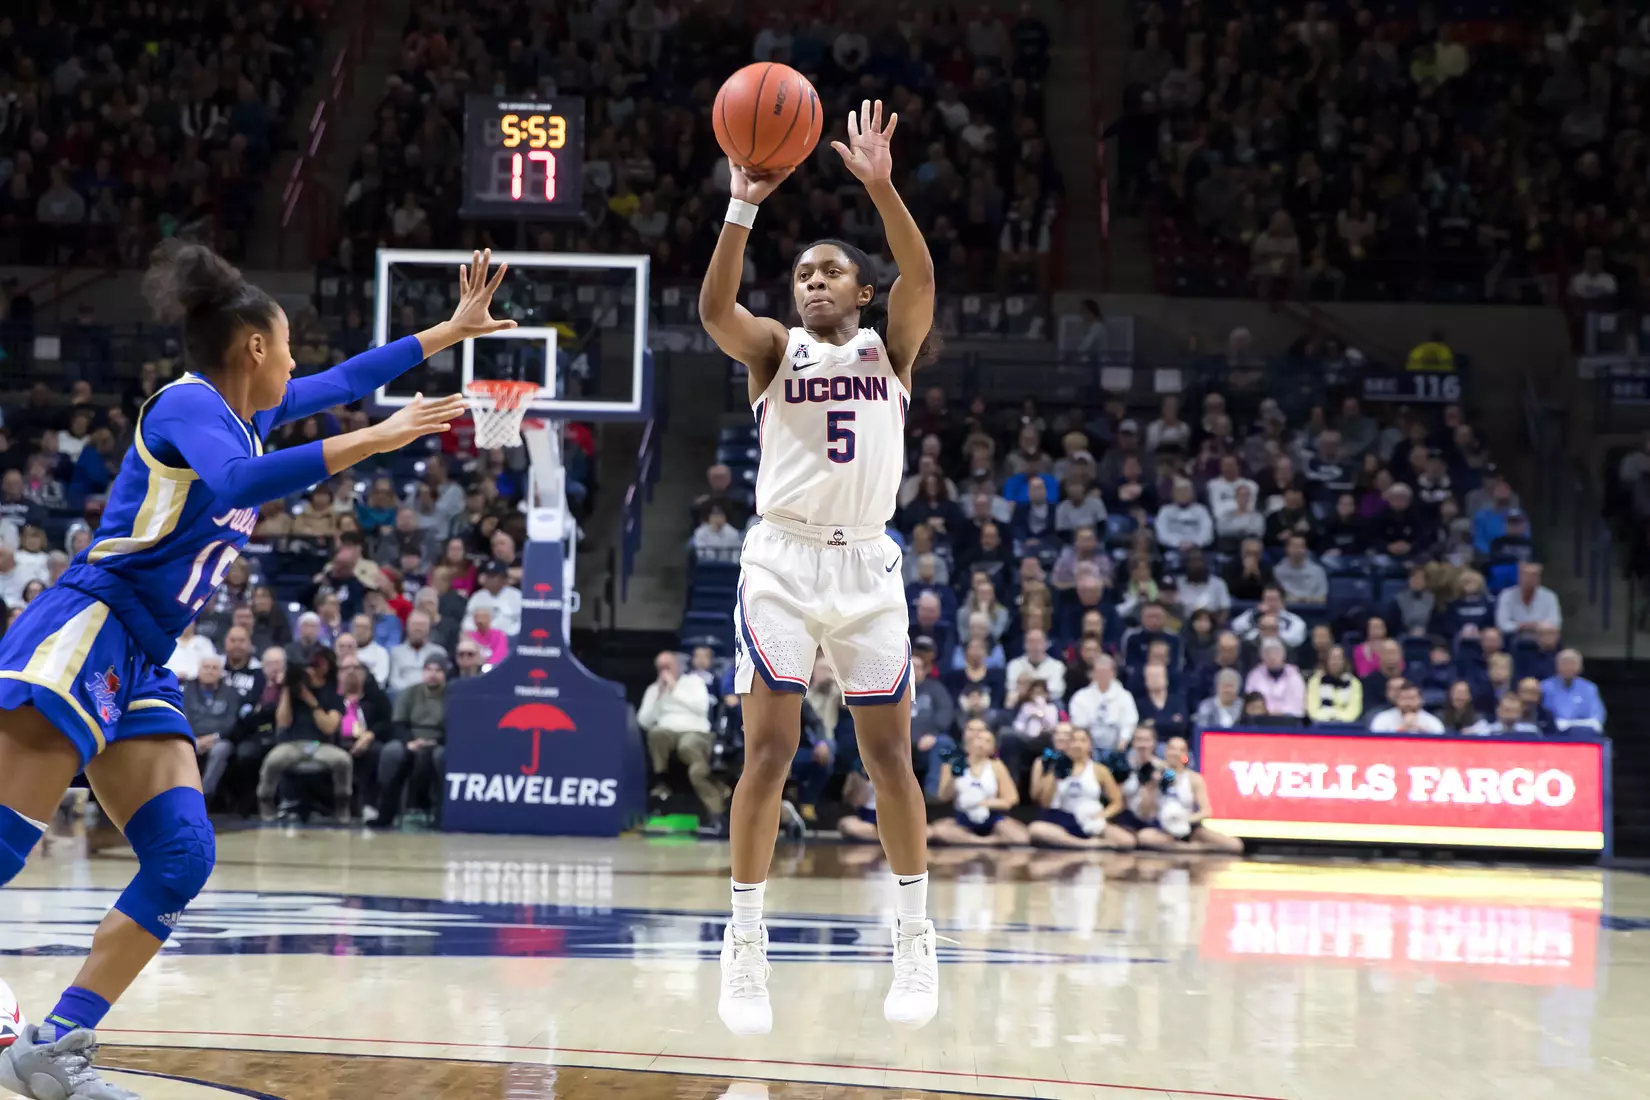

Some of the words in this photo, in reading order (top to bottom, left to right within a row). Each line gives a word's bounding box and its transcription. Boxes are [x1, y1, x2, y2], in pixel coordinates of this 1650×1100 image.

[501, 114, 566, 149] 5:53
[511, 150, 556, 202] 17
[784, 375, 889, 404] UCONN
[1412, 374, 1462, 399] 116
[826, 411, 856, 464] 5
[827, 539, 848, 547] UCONN
[446, 772, 618, 807] TRAVELERS
[1229, 761, 1397, 801] WELLS
[1407, 766, 1576, 807] FARGO
